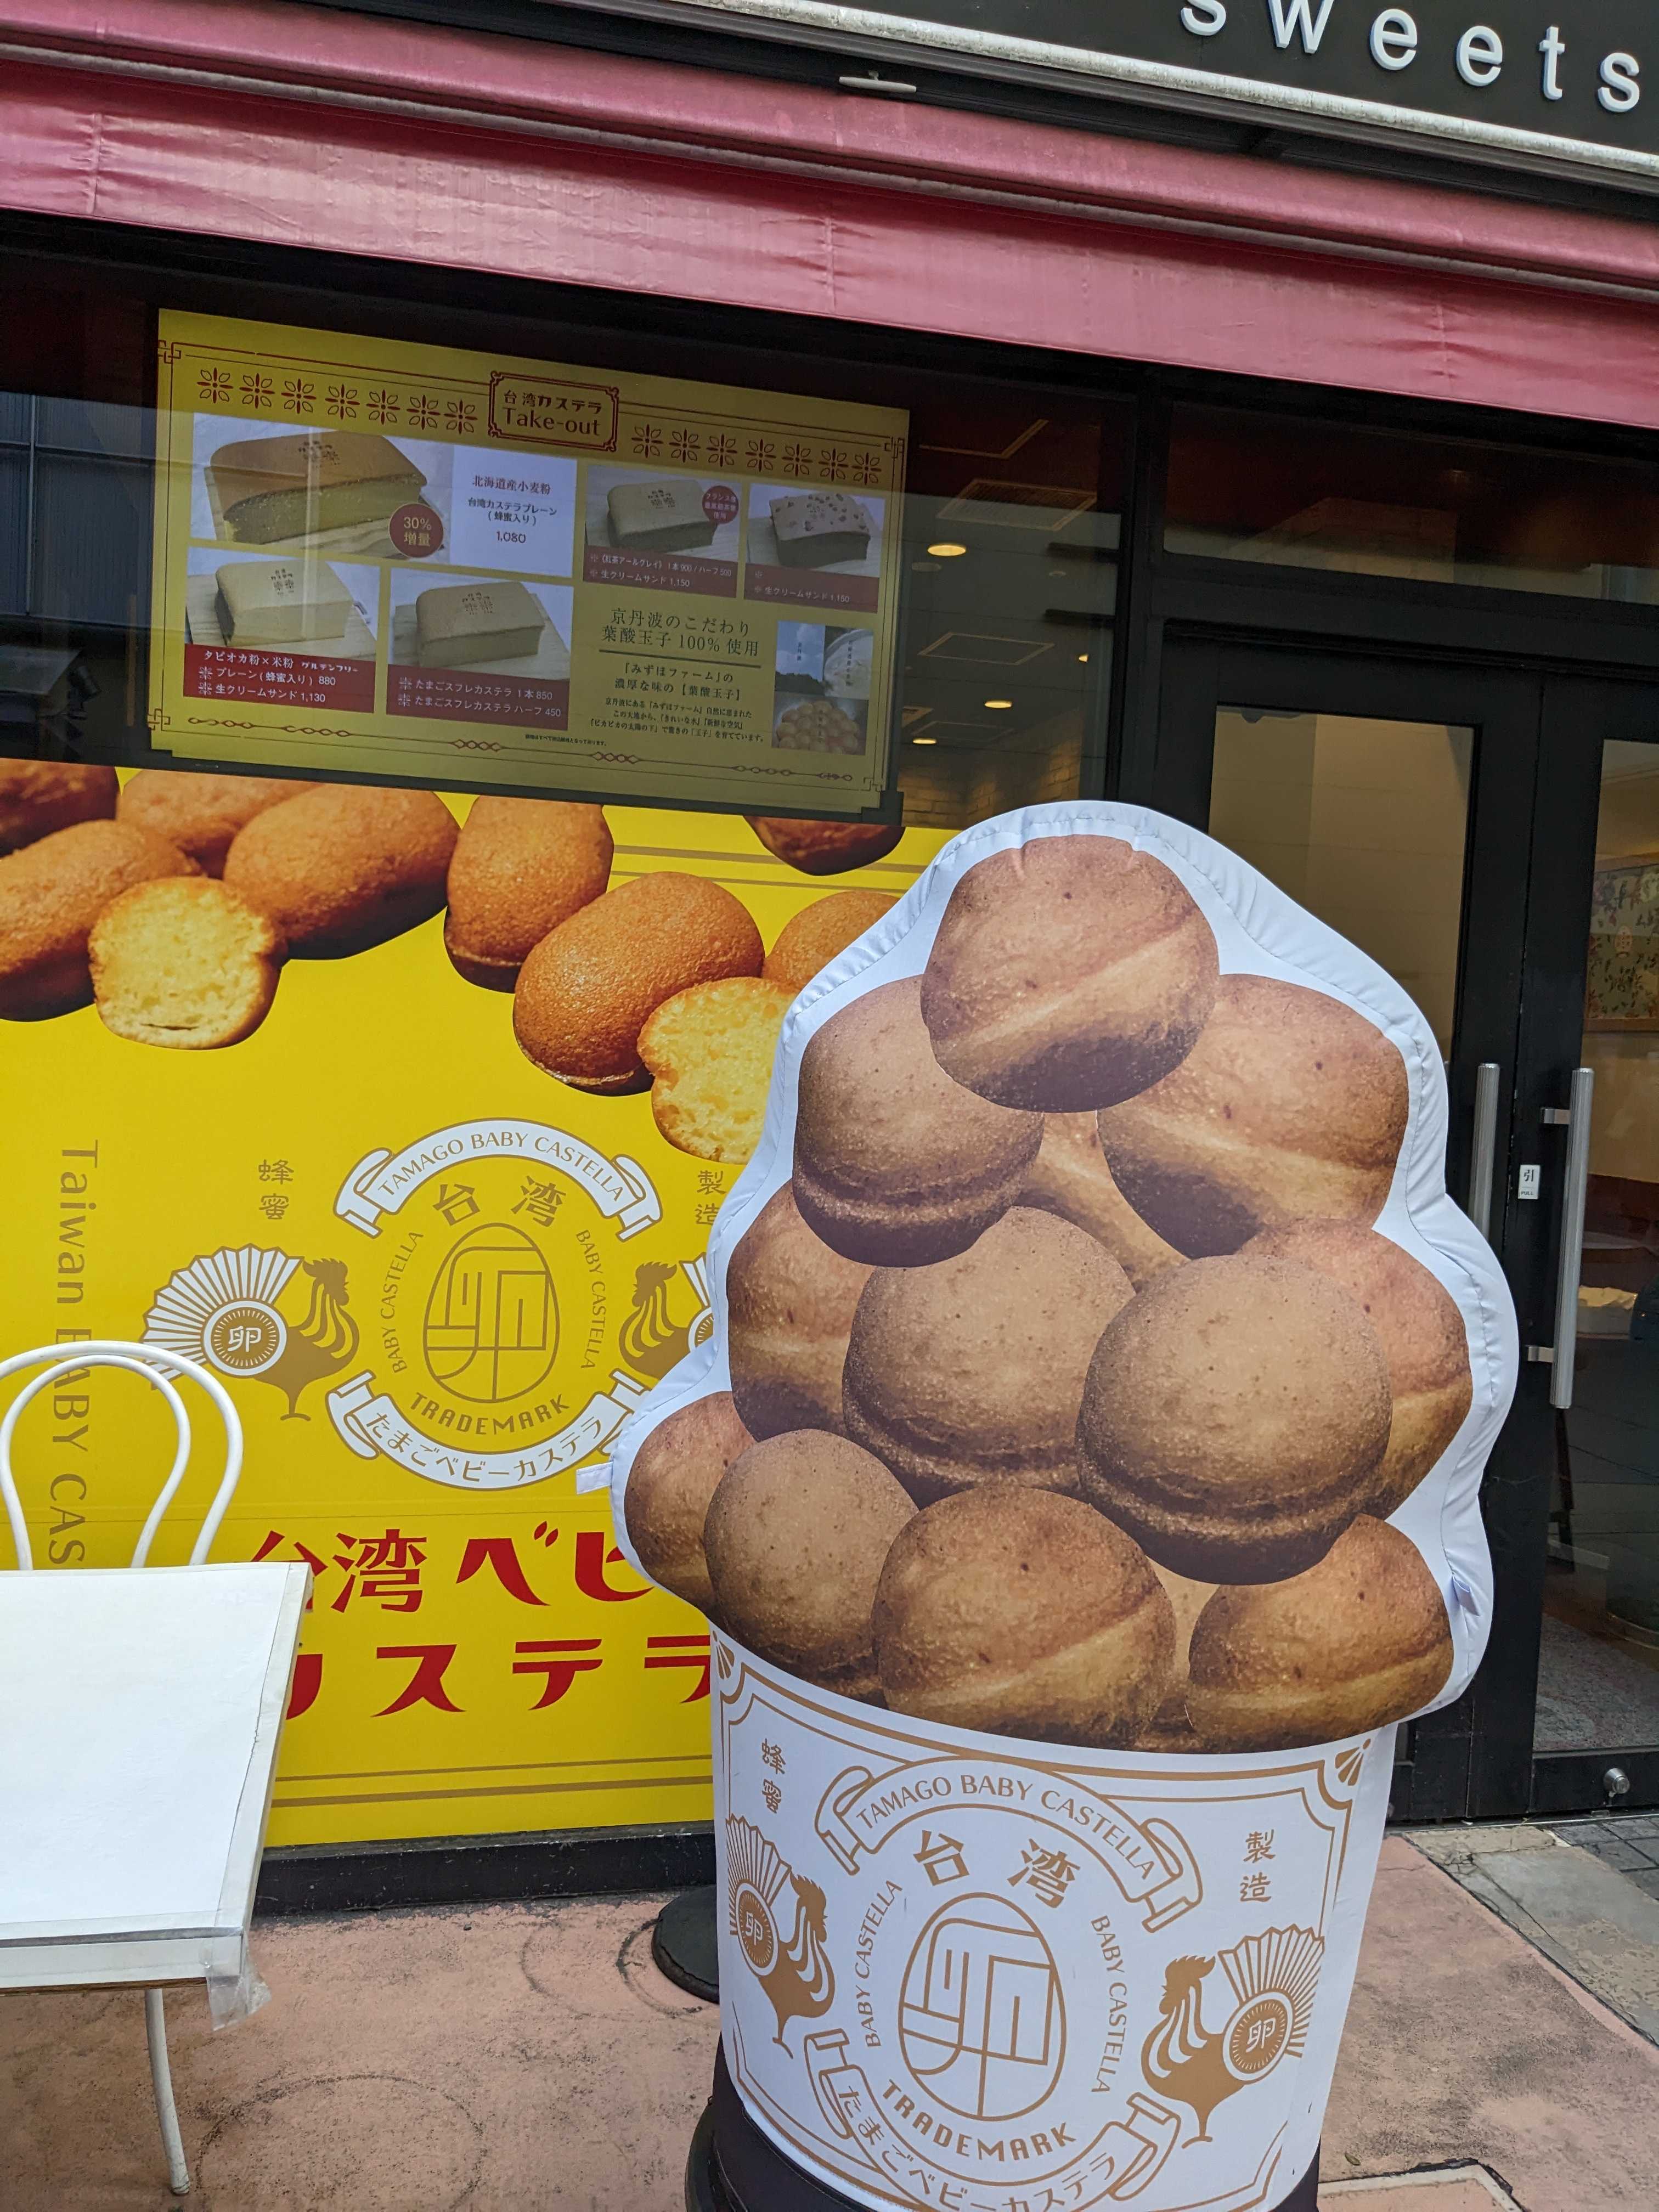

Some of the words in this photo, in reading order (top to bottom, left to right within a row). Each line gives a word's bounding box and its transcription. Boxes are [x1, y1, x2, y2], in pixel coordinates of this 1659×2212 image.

[1181, 0, 1640, 113] sweets
[502, 407, 601, 436] Take-out
[504, 390, 602, 414] 台湾カステラ
[468, 497, 557, 516] 台湾カステラプレーン
[472, 475, 551, 495] 北海道産小麦粉
[403, 516, 431, 531] 30%
[403, 531, 431, 548] 増量
[488, 511, 536, 526] (蜂蜜入り)
[496, 531, 526, 544] 1,080
[601, 569, 666, 584] 生クリームサンド
[670, 578, 690, 588] 1,150
[601, 625, 671, 648] 葉酸玉子
[611, 607, 748, 637] 京丹波のこだわり
[204, 650, 294, 669] タピオカ粉×米粉
[301, 661, 359, 674] グルテンフリー
[318, 675, 336, 686] 880
[215, 684, 298, 701] 生クリームサンド
[301, 692, 326, 703] 1,130
[415, 679, 513, 697] たまごスフレカステラ
[545, 708, 561, 718] 450
[377, 1139, 464, 1198] TAMAGO
[470, 1131, 529, 1150] BABY
[534, 1137, 624, 1203] CASTELLA
[1523, 1169, 1534, 1182] 引
[257, 1159, 295, 1221] 蜂蜜
[432, 1175, 567, 1228] 台湾
[695, 1170, 727, 1226] 製造
[55, 1139, 99, 1305] Taiwan
[576, 1229, 603, 1274] BABY
[380, 1232, 424, 1319] CASTELLA
[227, 1324, 263, 1353] 卵
[580, 1281, 606, 1369] CASTELLA
[381, 1327, 408, 1373] BABY
[409, 1392, 571, 1436] TRADEMARK
[366, 1410, 605, 1483] たまごベビーカステラ
[48, 1473, 88, 1565] CAS
[761, 1738, 786, 1814] 蜂蜜
[855, 1775, 952, 1830] TAMAGO
[961, 1773, 1034, 1801] BABY
[1040, 1789, 1155, 1880] CASTELLA
[913, 1829, 1080, 1909] 台湾
[1239, 1829, 1276, 1903] 製造
[746, 1912, 763, 1946] 卵
[855, 1880, 902, 1979] CASTELLA
[1091, 1915, 1125, 1973] BABY
[855, 1984, 882, 2047] BABY
[1091, 1982, 1127, 2092] CASTELLA
[1245, 2019, 1277, 2053] 卵
[882, 2079, 1076, 2162] TRADEMARK
